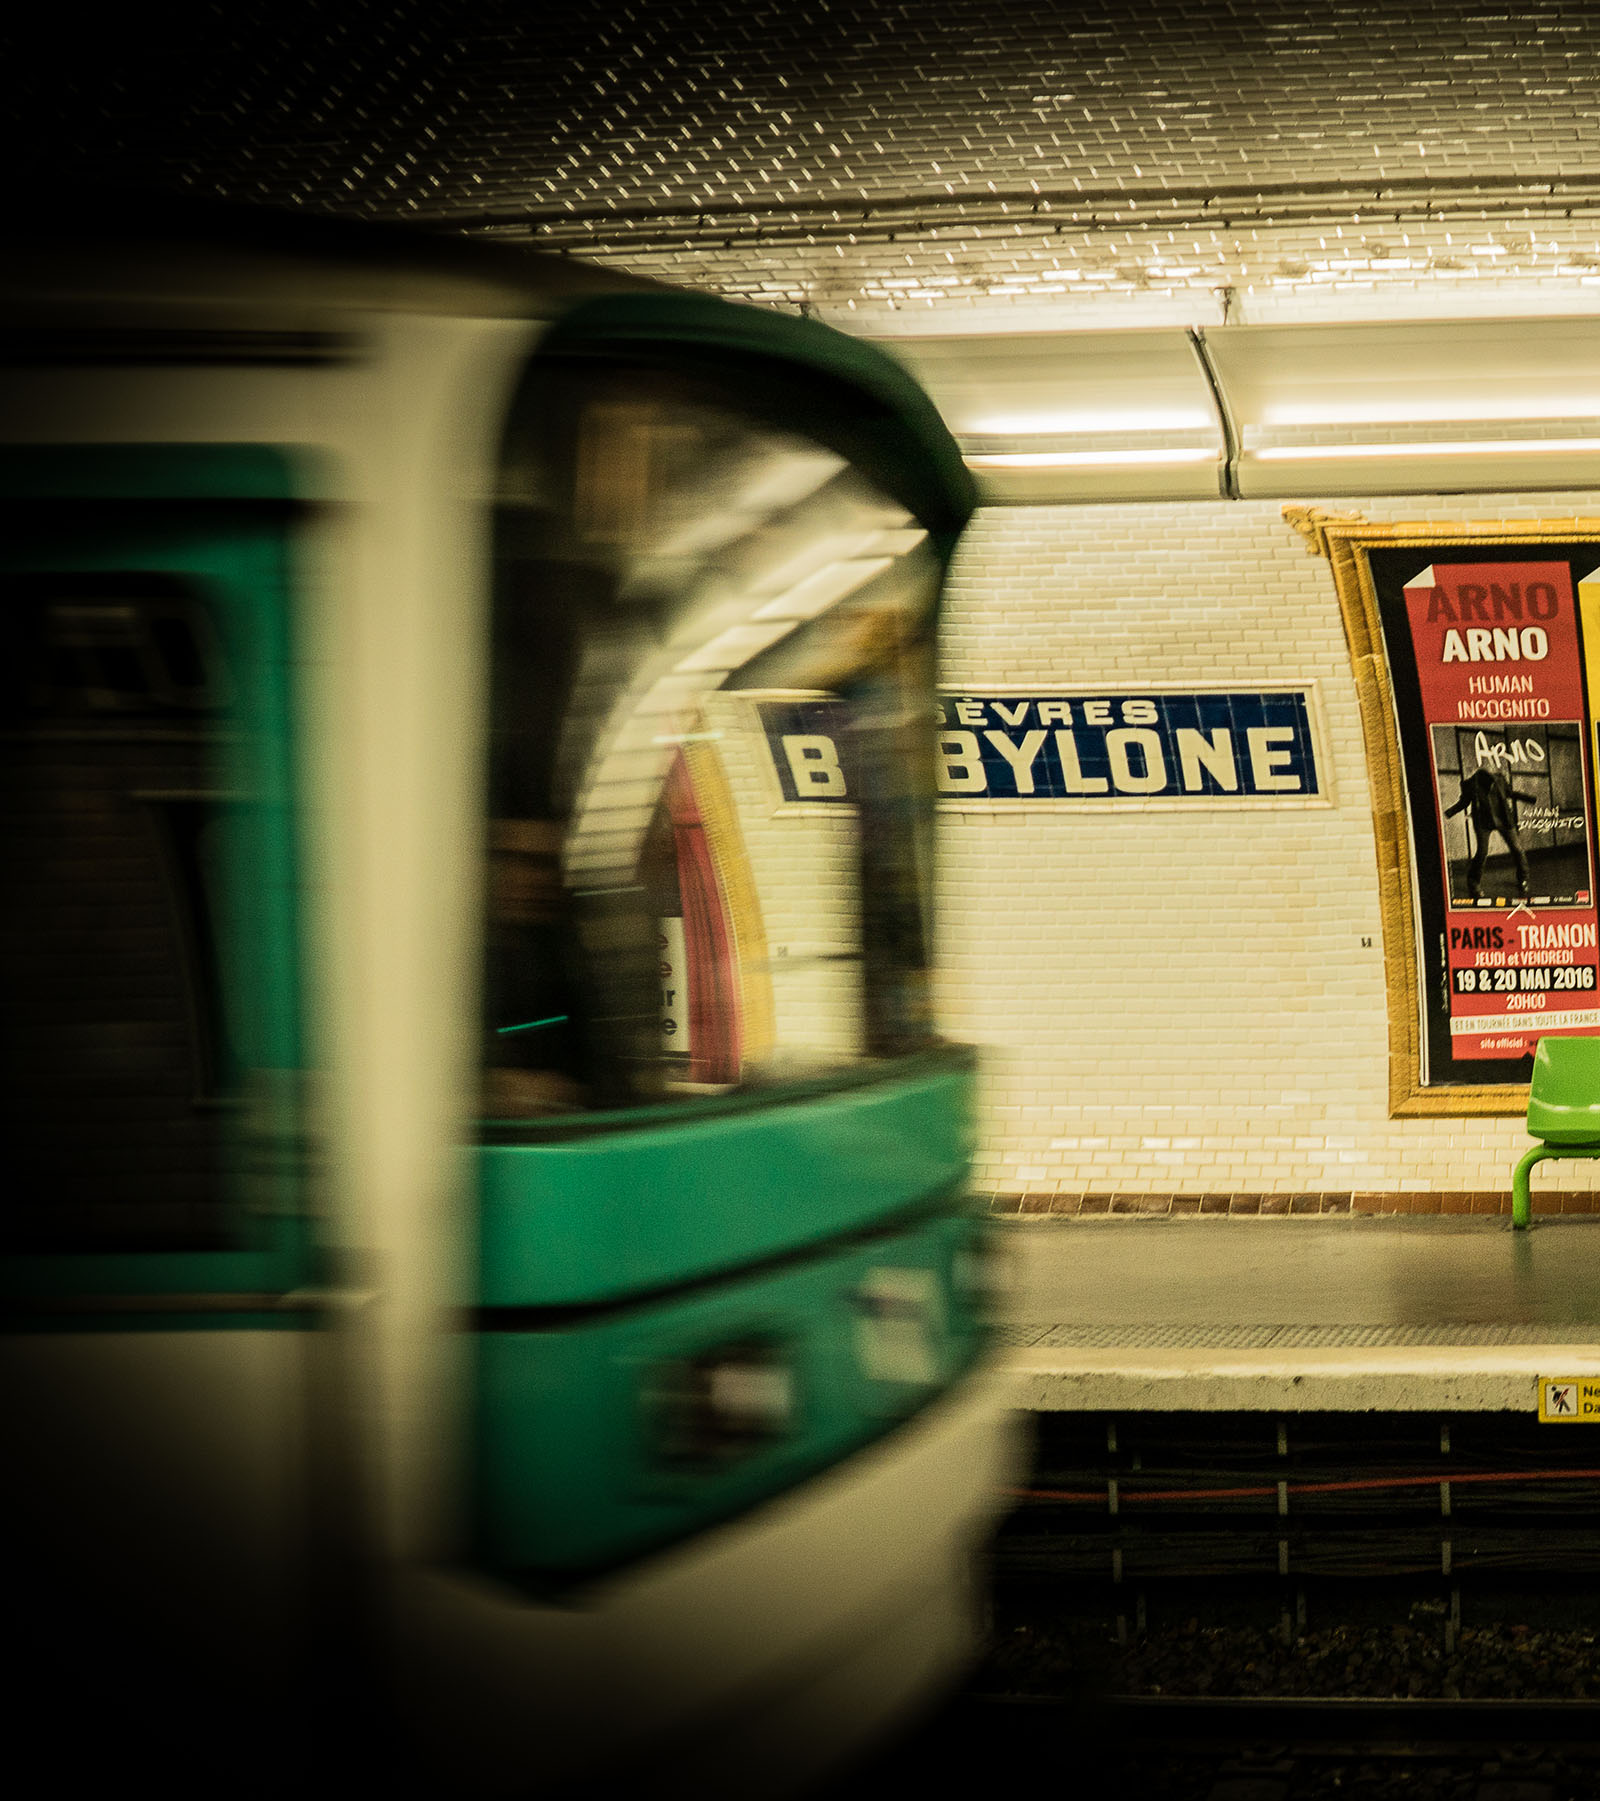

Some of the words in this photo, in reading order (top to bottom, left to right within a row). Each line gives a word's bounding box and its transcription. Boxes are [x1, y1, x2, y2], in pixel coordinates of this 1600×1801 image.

[1427, 582, 1559, 622] ARNO
[1442, 626, 1548, 663] ARNO
[1469, 674, 1533, 694] HUMAN
[1458, 698, 1549, 719] INCOGNITO
[782, 727, 1301, 797] BBYLONE
[1451, 927, 1504, 950] PARIS
[1517, 923, 1596, 949] TRIANON
[1475, 951, 1506, 966] JEUDI
[1508, 953, 1519, 965] et
[1520, 950, 1574, 965] VENDREDI
[1456, 969, 1476, 992] 19
[1479, 969, 1492, 991] &
[1494, 969, 1516, 991] 20
[1520, 968, 1550, 990] MAI
[1553, 967, 1594, 989] 2016
[1454, 1020, 1464, 1031] ET
[1465, 1020, 1475, 1031] EN
[1477, 1015, 1511, 1030] TOURNÉE
[1513, 1016, 1533, 1028] DANS
[1535, 1014, 1557, 1027] TOUTE
[1559, 1014, 1568, 1025] LA
[1569, 1012, 1598, 1025] FRANCE
[1480, 1038, 1495, 1049] site
[1583, 1385, 1600, 1397] Ne
